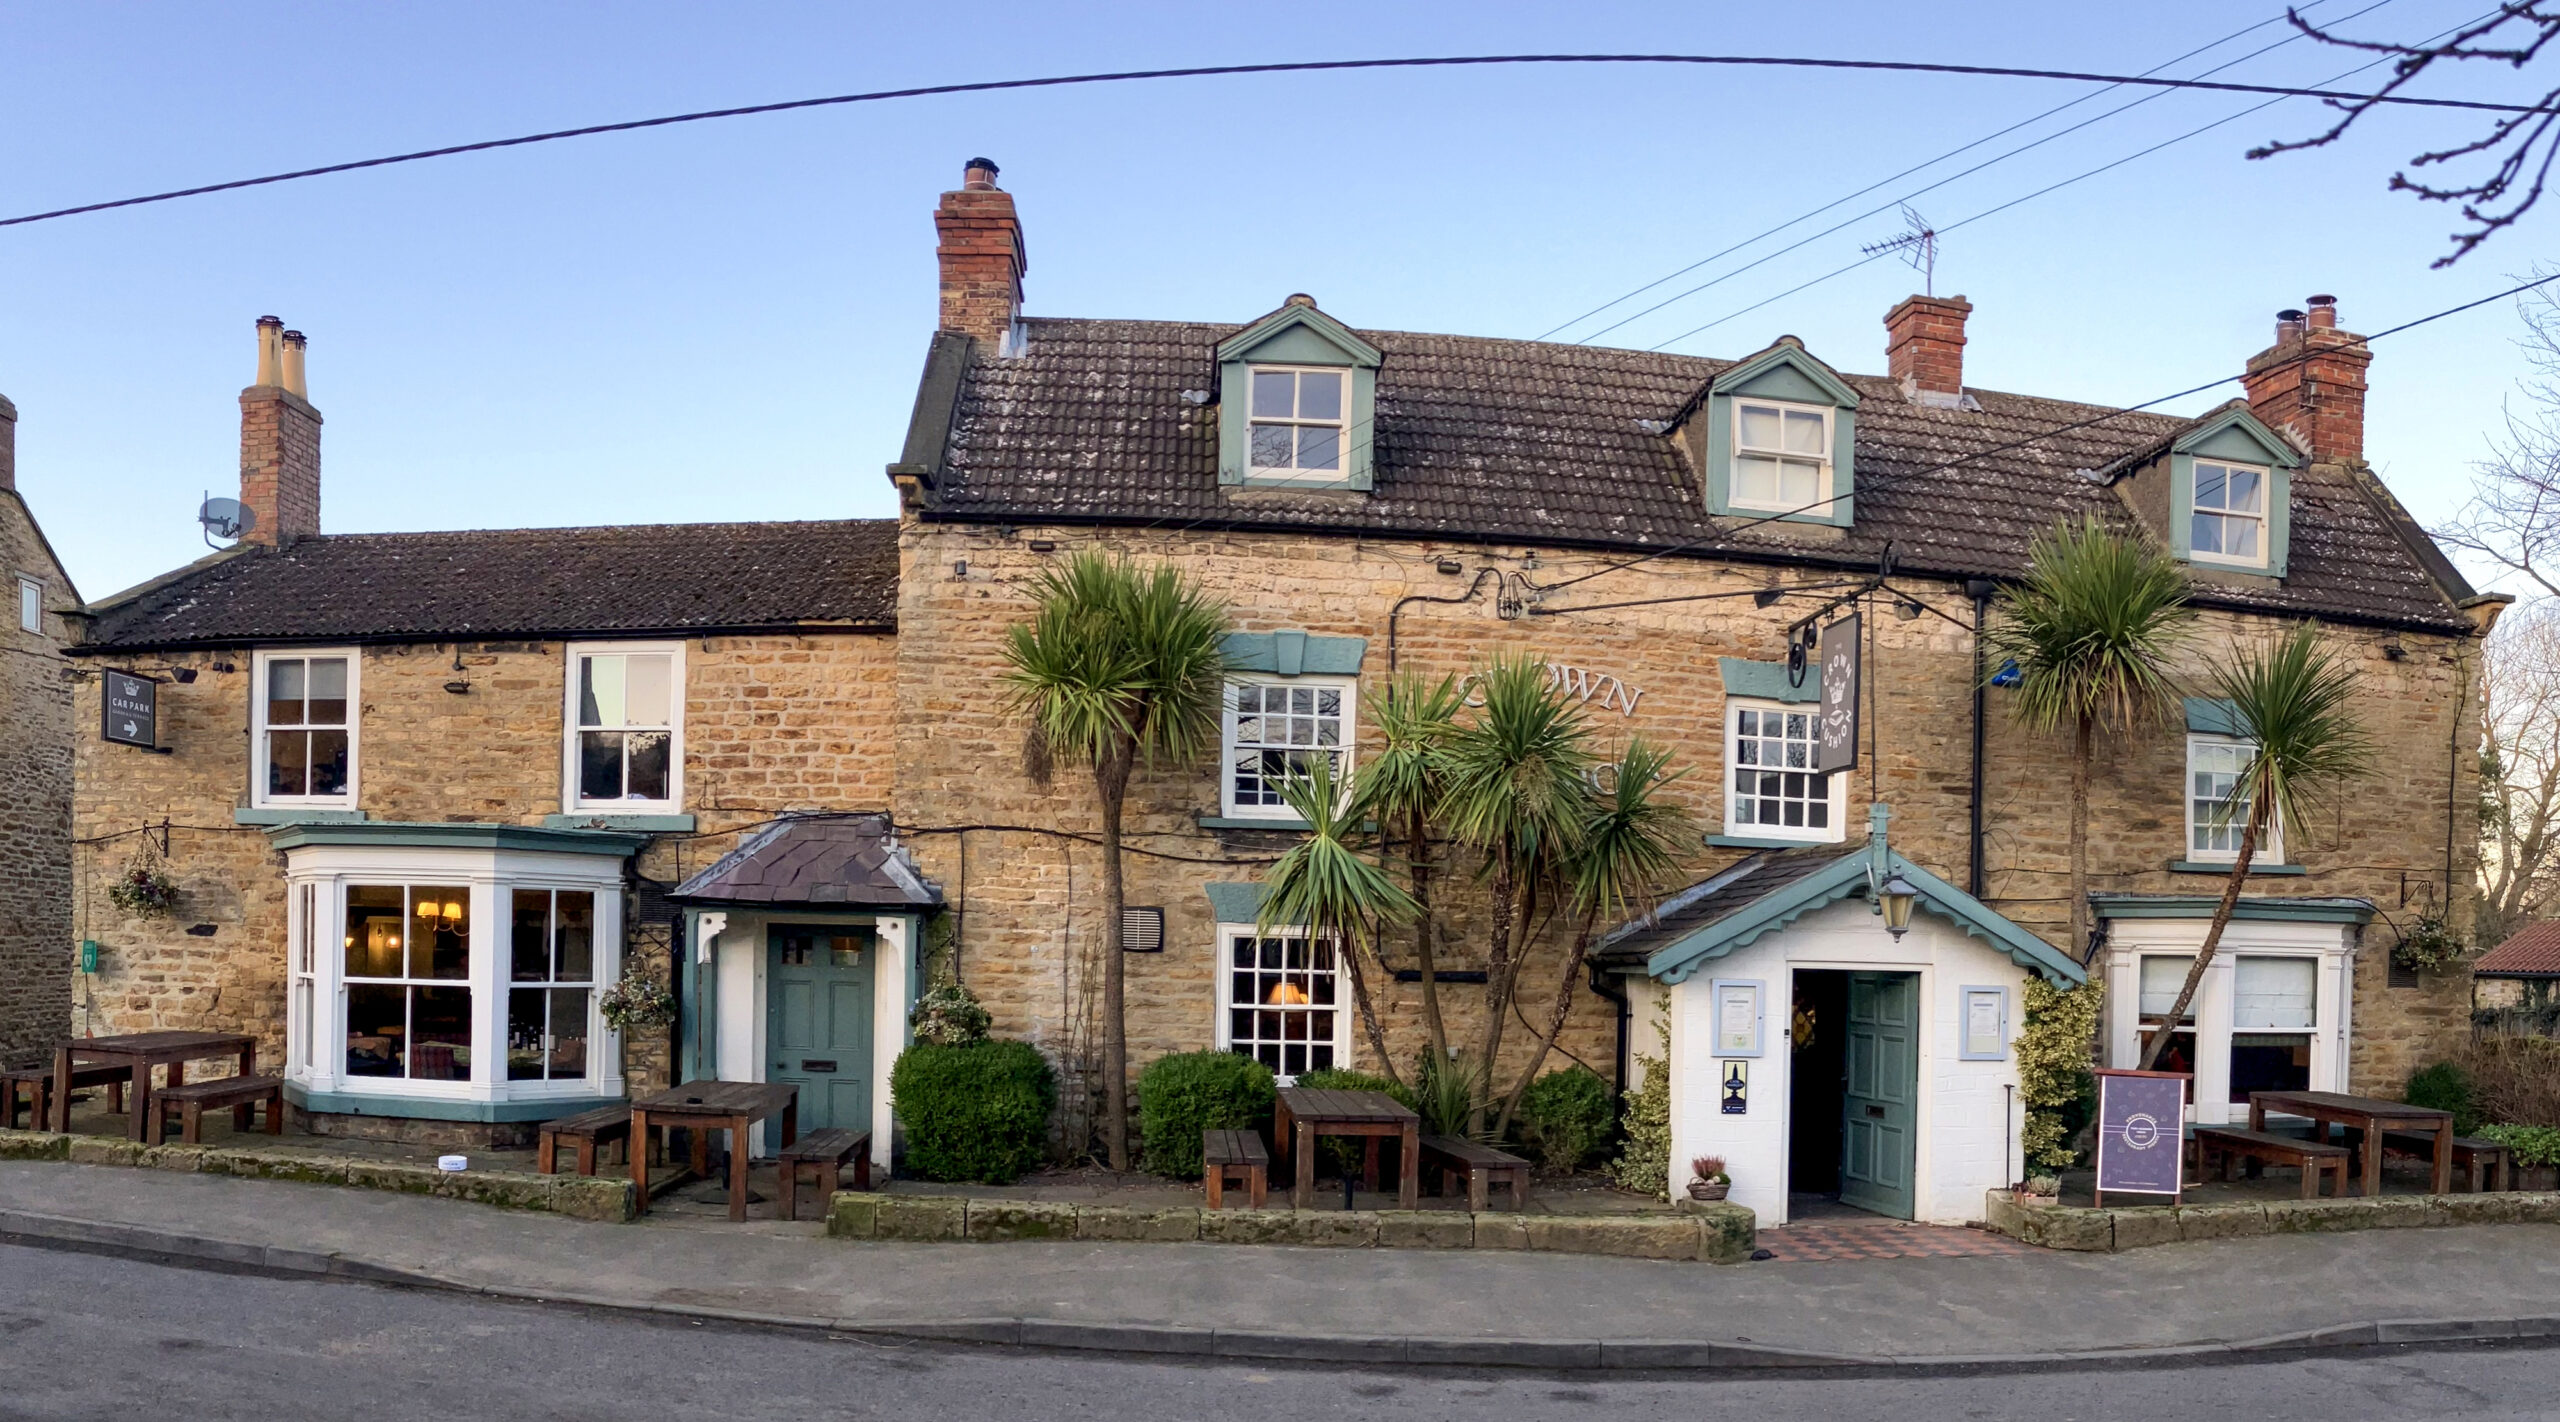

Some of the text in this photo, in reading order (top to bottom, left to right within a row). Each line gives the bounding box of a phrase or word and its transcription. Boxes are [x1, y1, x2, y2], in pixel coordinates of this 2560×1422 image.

[1823, 653, 1852, 686] CROWN
[112, 697, 150, 714] CAR PARK
[1821, 710, 1852, 749] CUSHION
